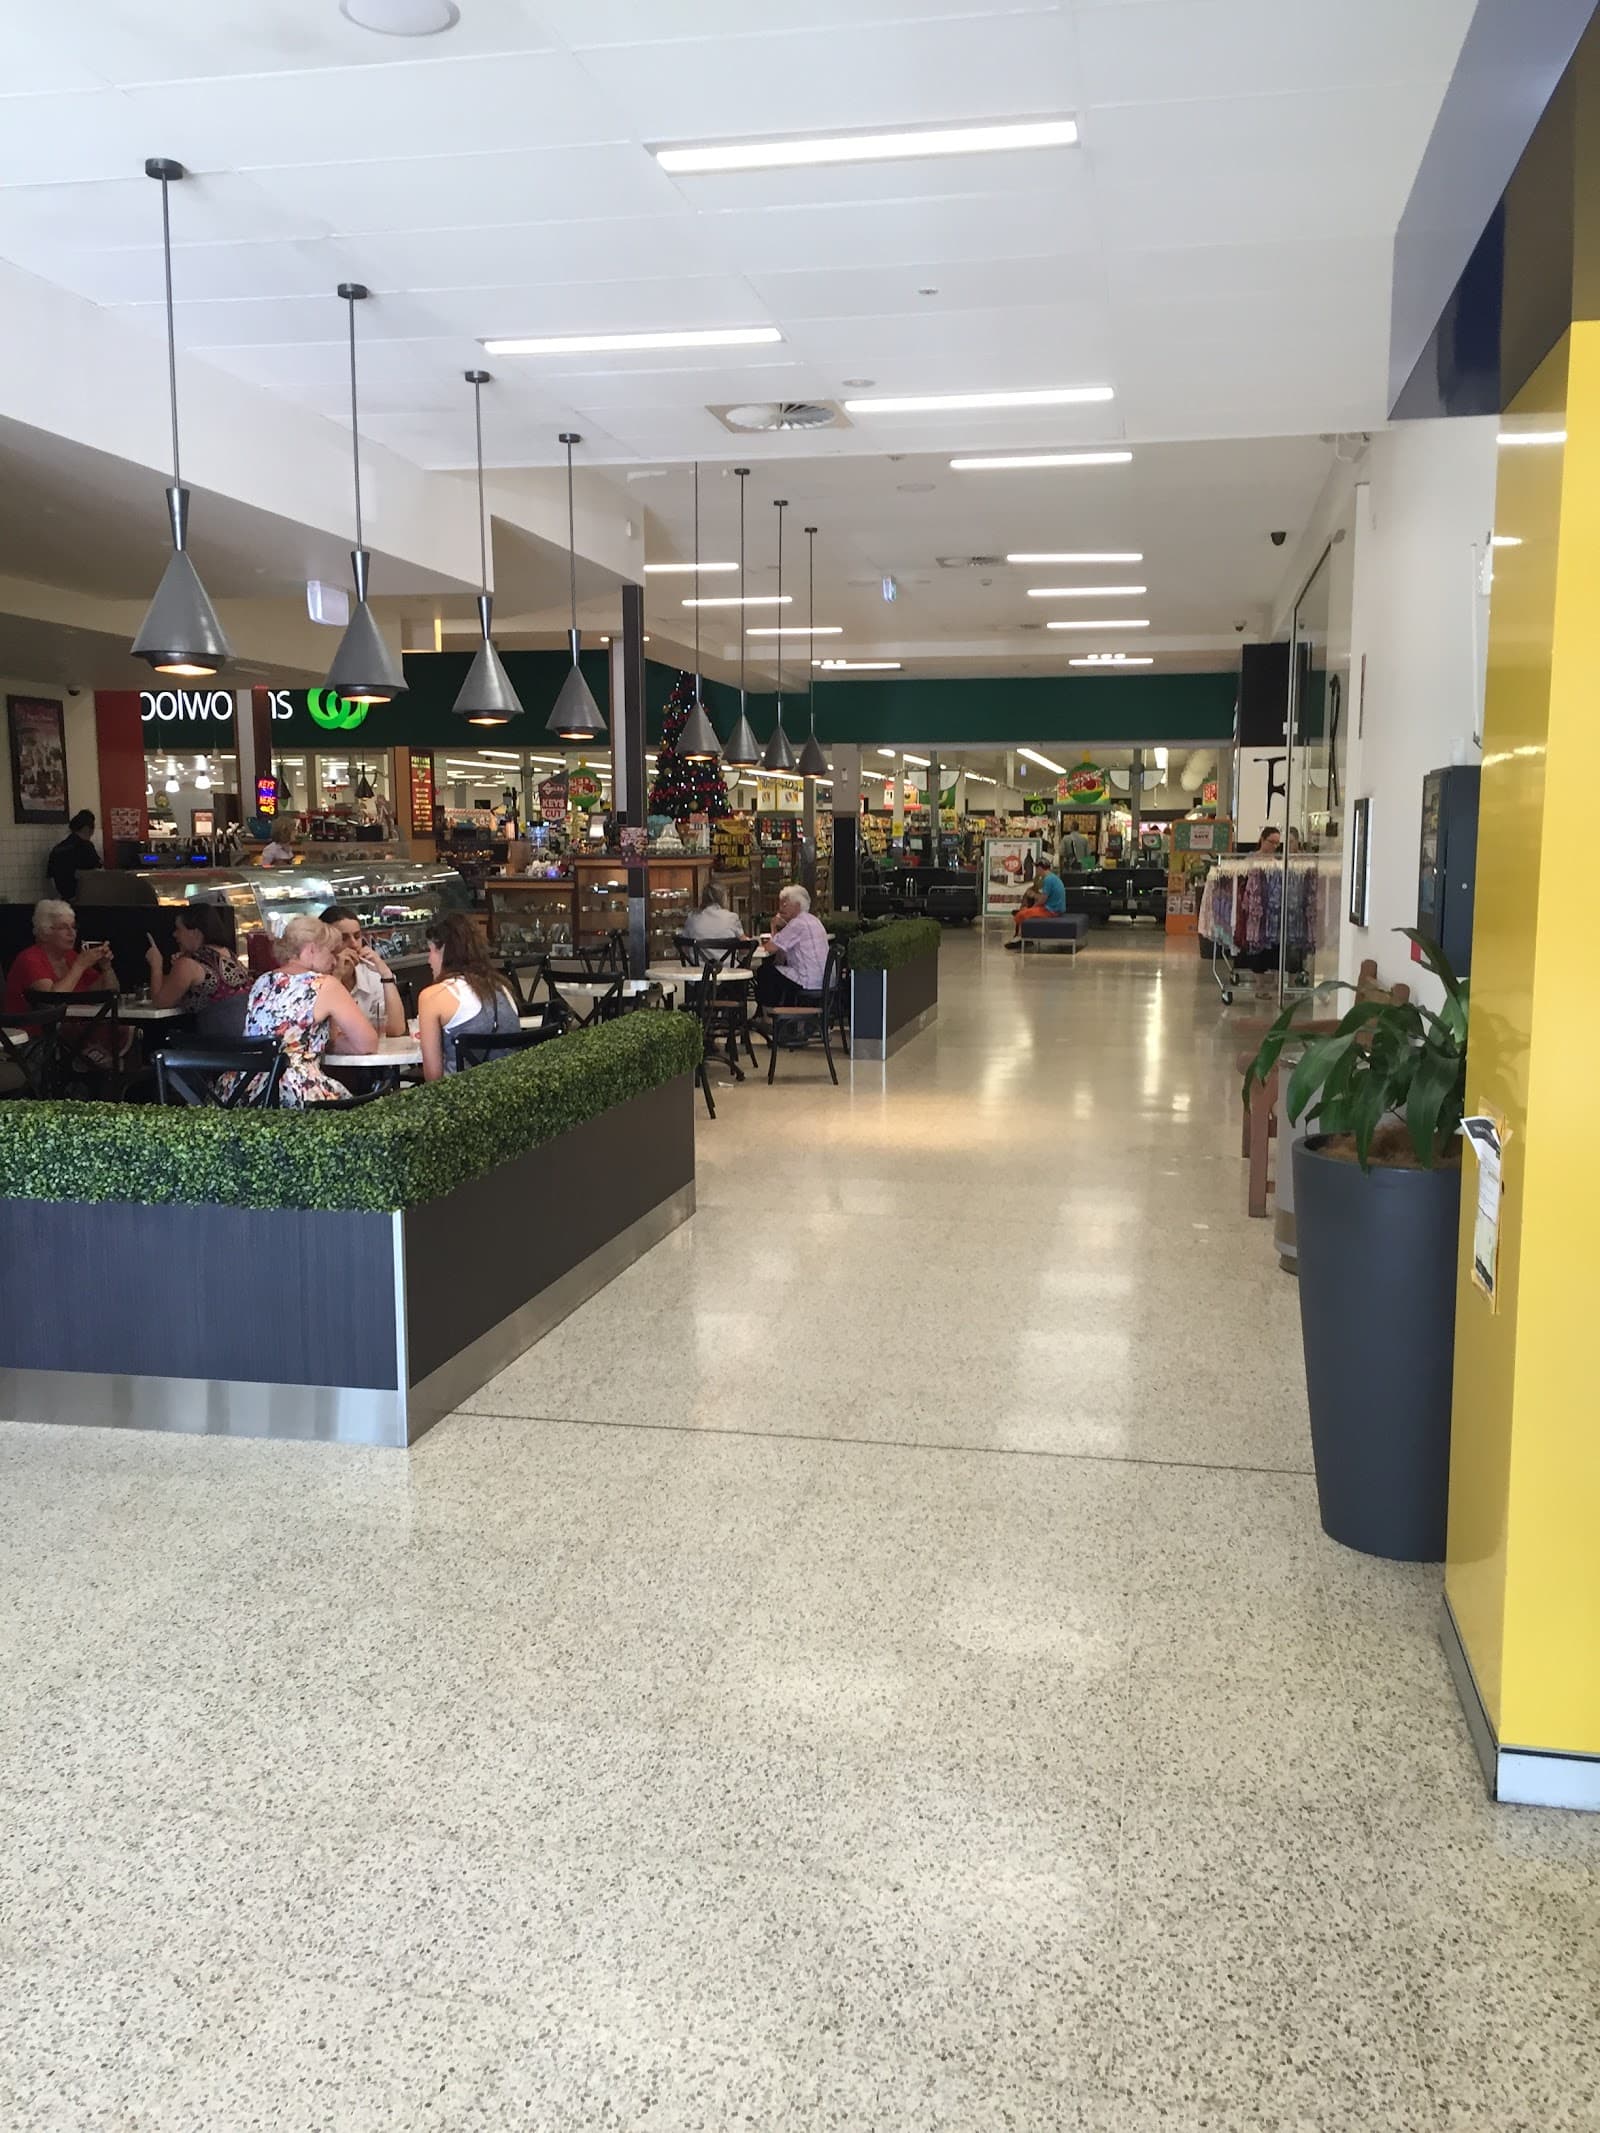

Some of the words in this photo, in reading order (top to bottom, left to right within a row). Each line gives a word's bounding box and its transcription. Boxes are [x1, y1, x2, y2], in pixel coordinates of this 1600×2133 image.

[257, 779, 276, 789] KEYS
[542, 799, 565, 808] KEYS
[545, 809, 562, 818] CUT
